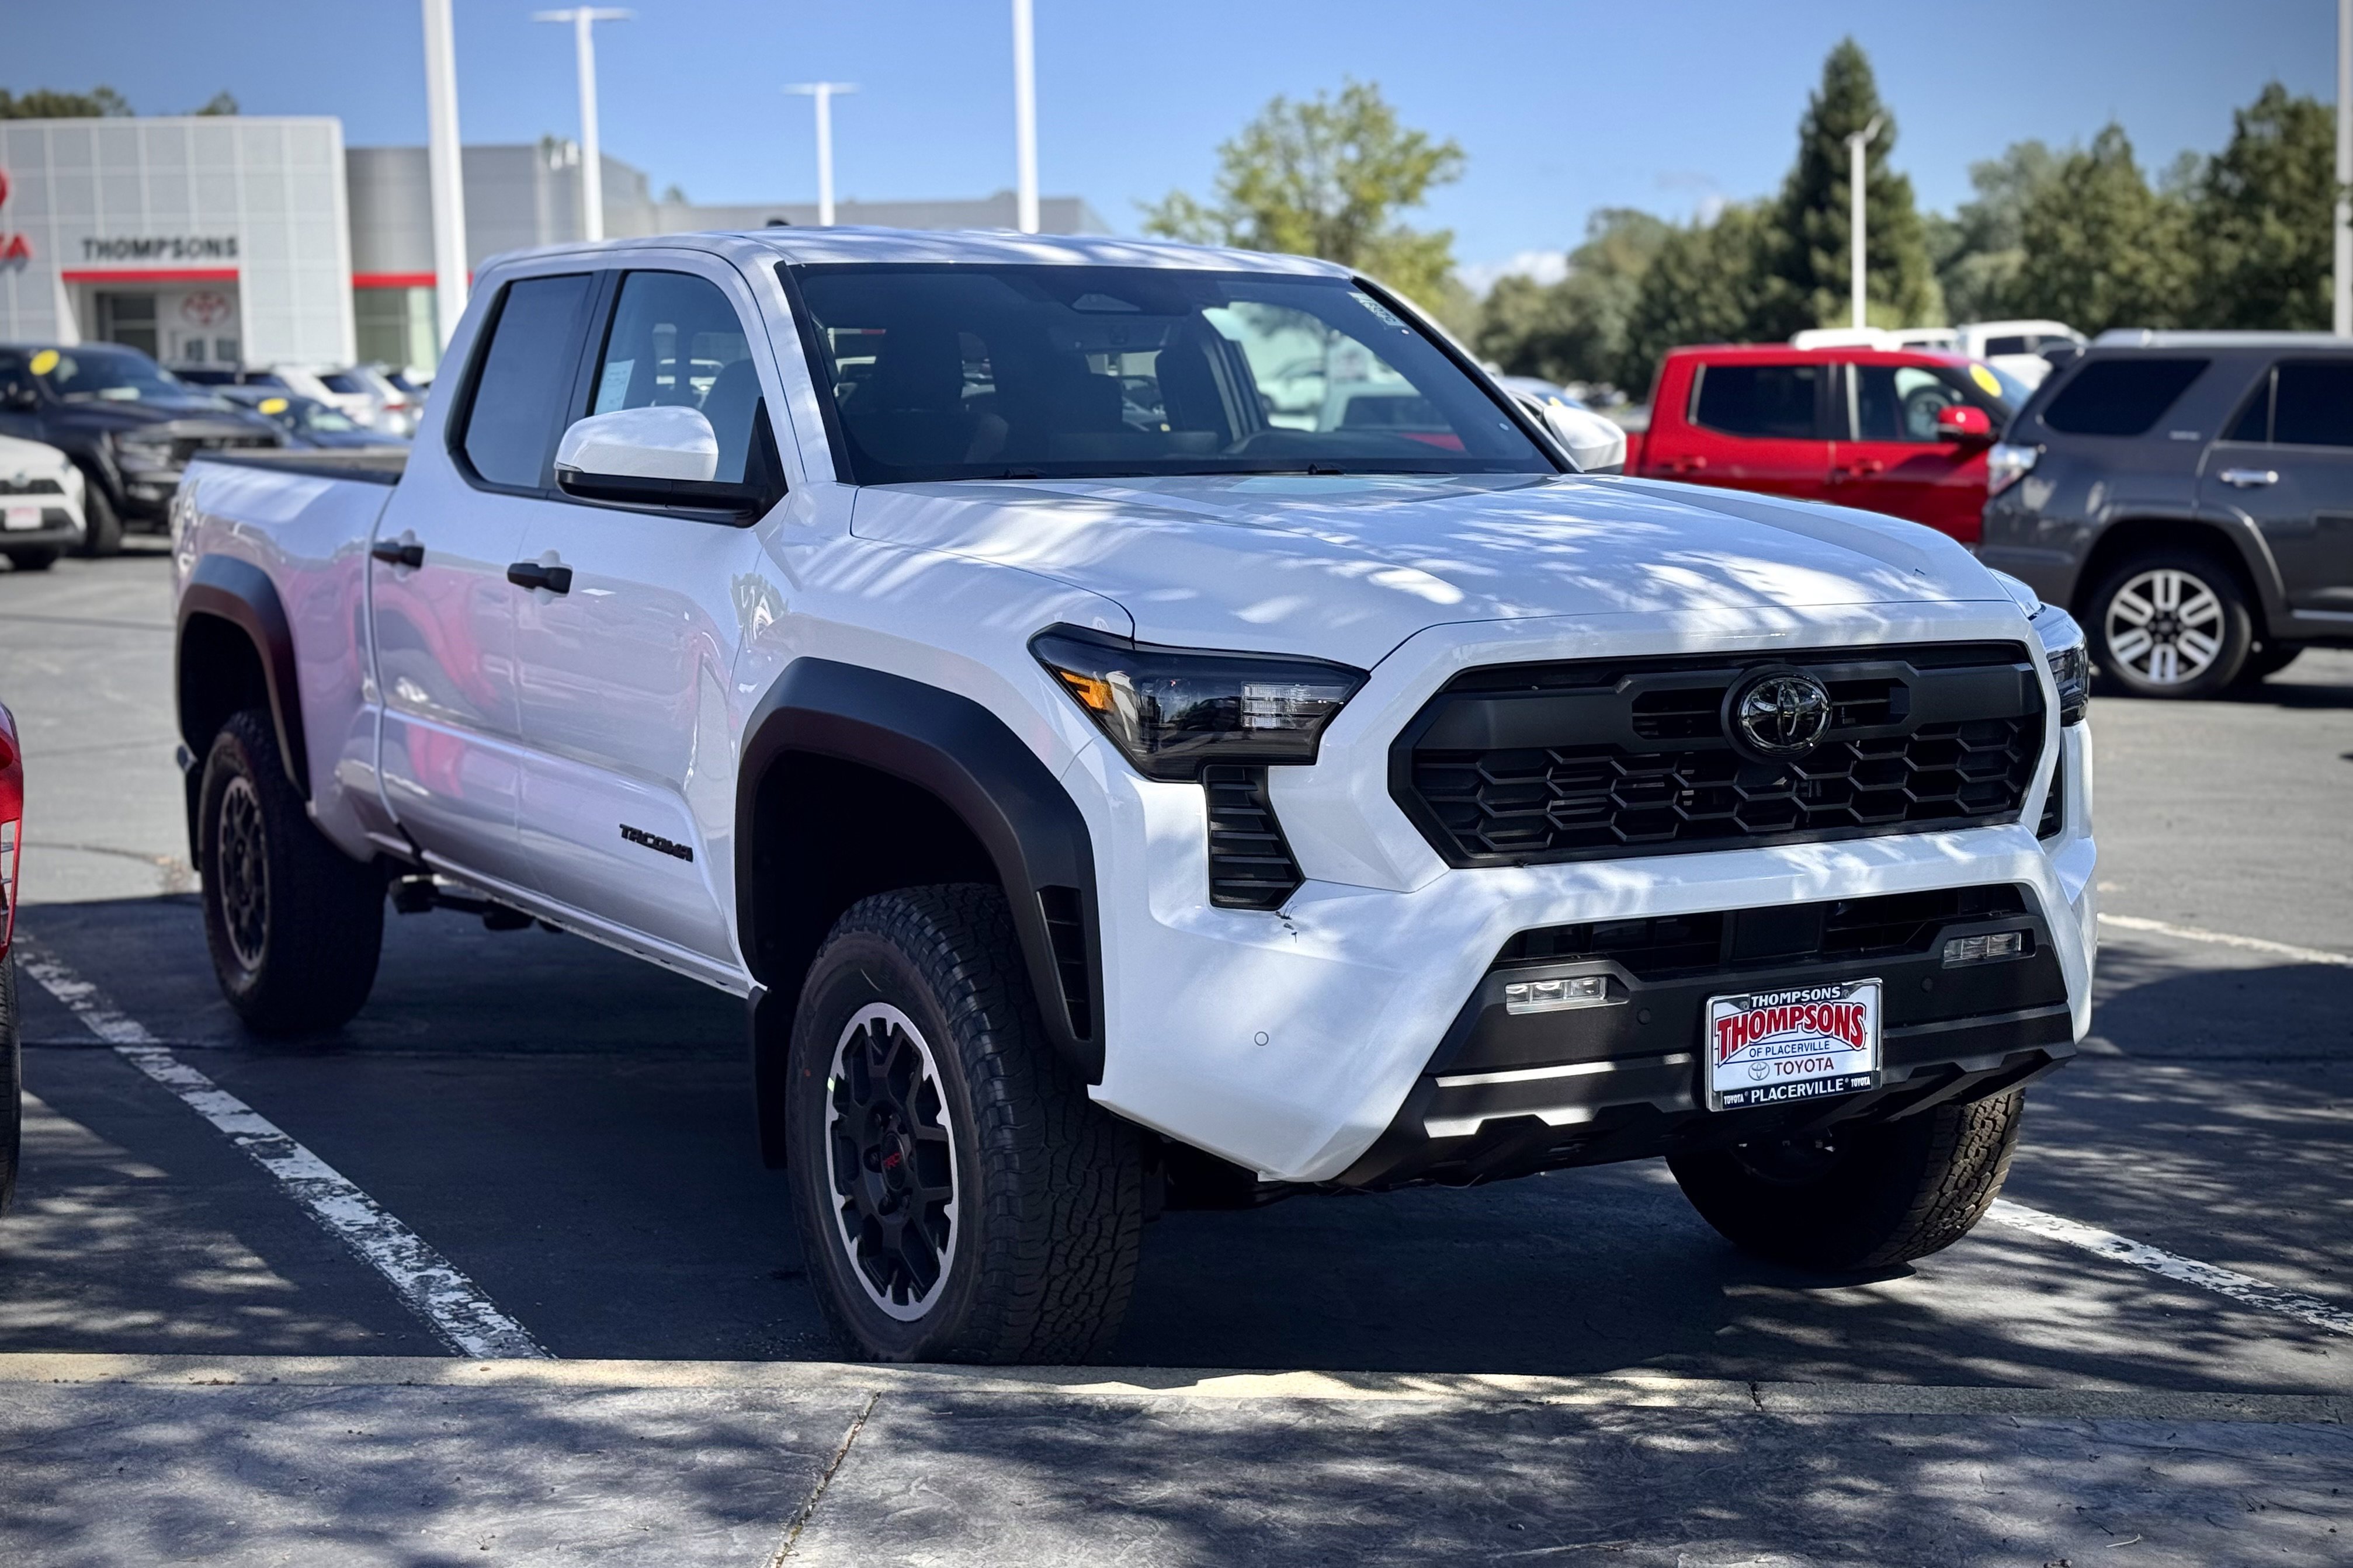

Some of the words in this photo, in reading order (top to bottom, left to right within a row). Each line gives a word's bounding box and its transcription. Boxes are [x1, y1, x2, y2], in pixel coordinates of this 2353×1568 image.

[82, 236, 239, 261] THOMPSONS
[1751, 986, 1841, 1007] THOMPSONS
[1717, 1002, 1865, 1065] THOMPSONS
[1750, 1047, 1762, 1058] OF
[1765, 1040, 1831, 1056] PLACERVILLE
[1774, 1056, 1834, 1076] TOYOTA
[1724, 1093, 1744, 1105] TOYOTA
[1751, 1078, 1844, 1103] PLACERVILLE
[1851, 1076, 1870, 1088] TOYOTA
